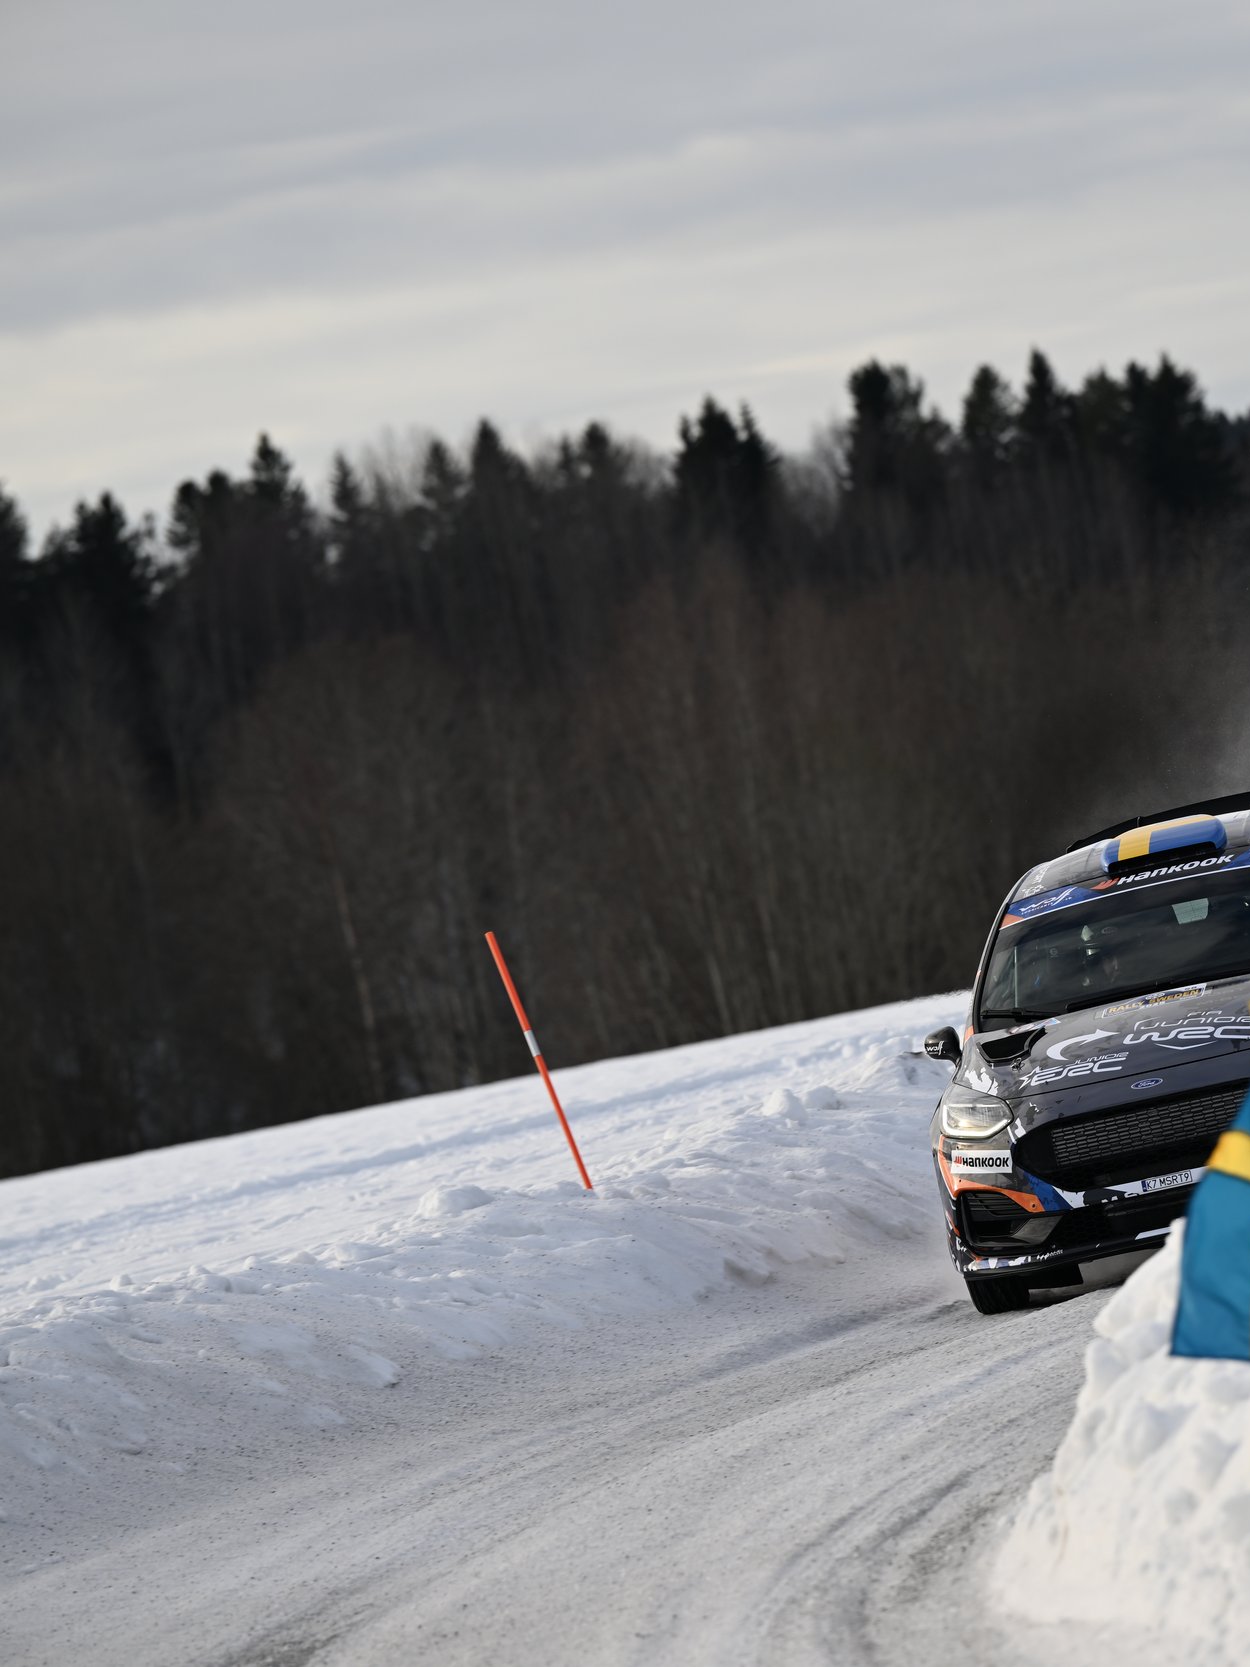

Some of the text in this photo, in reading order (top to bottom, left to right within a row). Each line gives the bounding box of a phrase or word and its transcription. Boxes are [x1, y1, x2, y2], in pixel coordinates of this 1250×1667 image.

[1108, 1000, 1145, 1014] RALLY
[1148, 988, 1201, 1005] SWEDEN
[1146, 1178, 1158, 1191] K7
[1159, 1172, 1191, 1188] MSRT9
